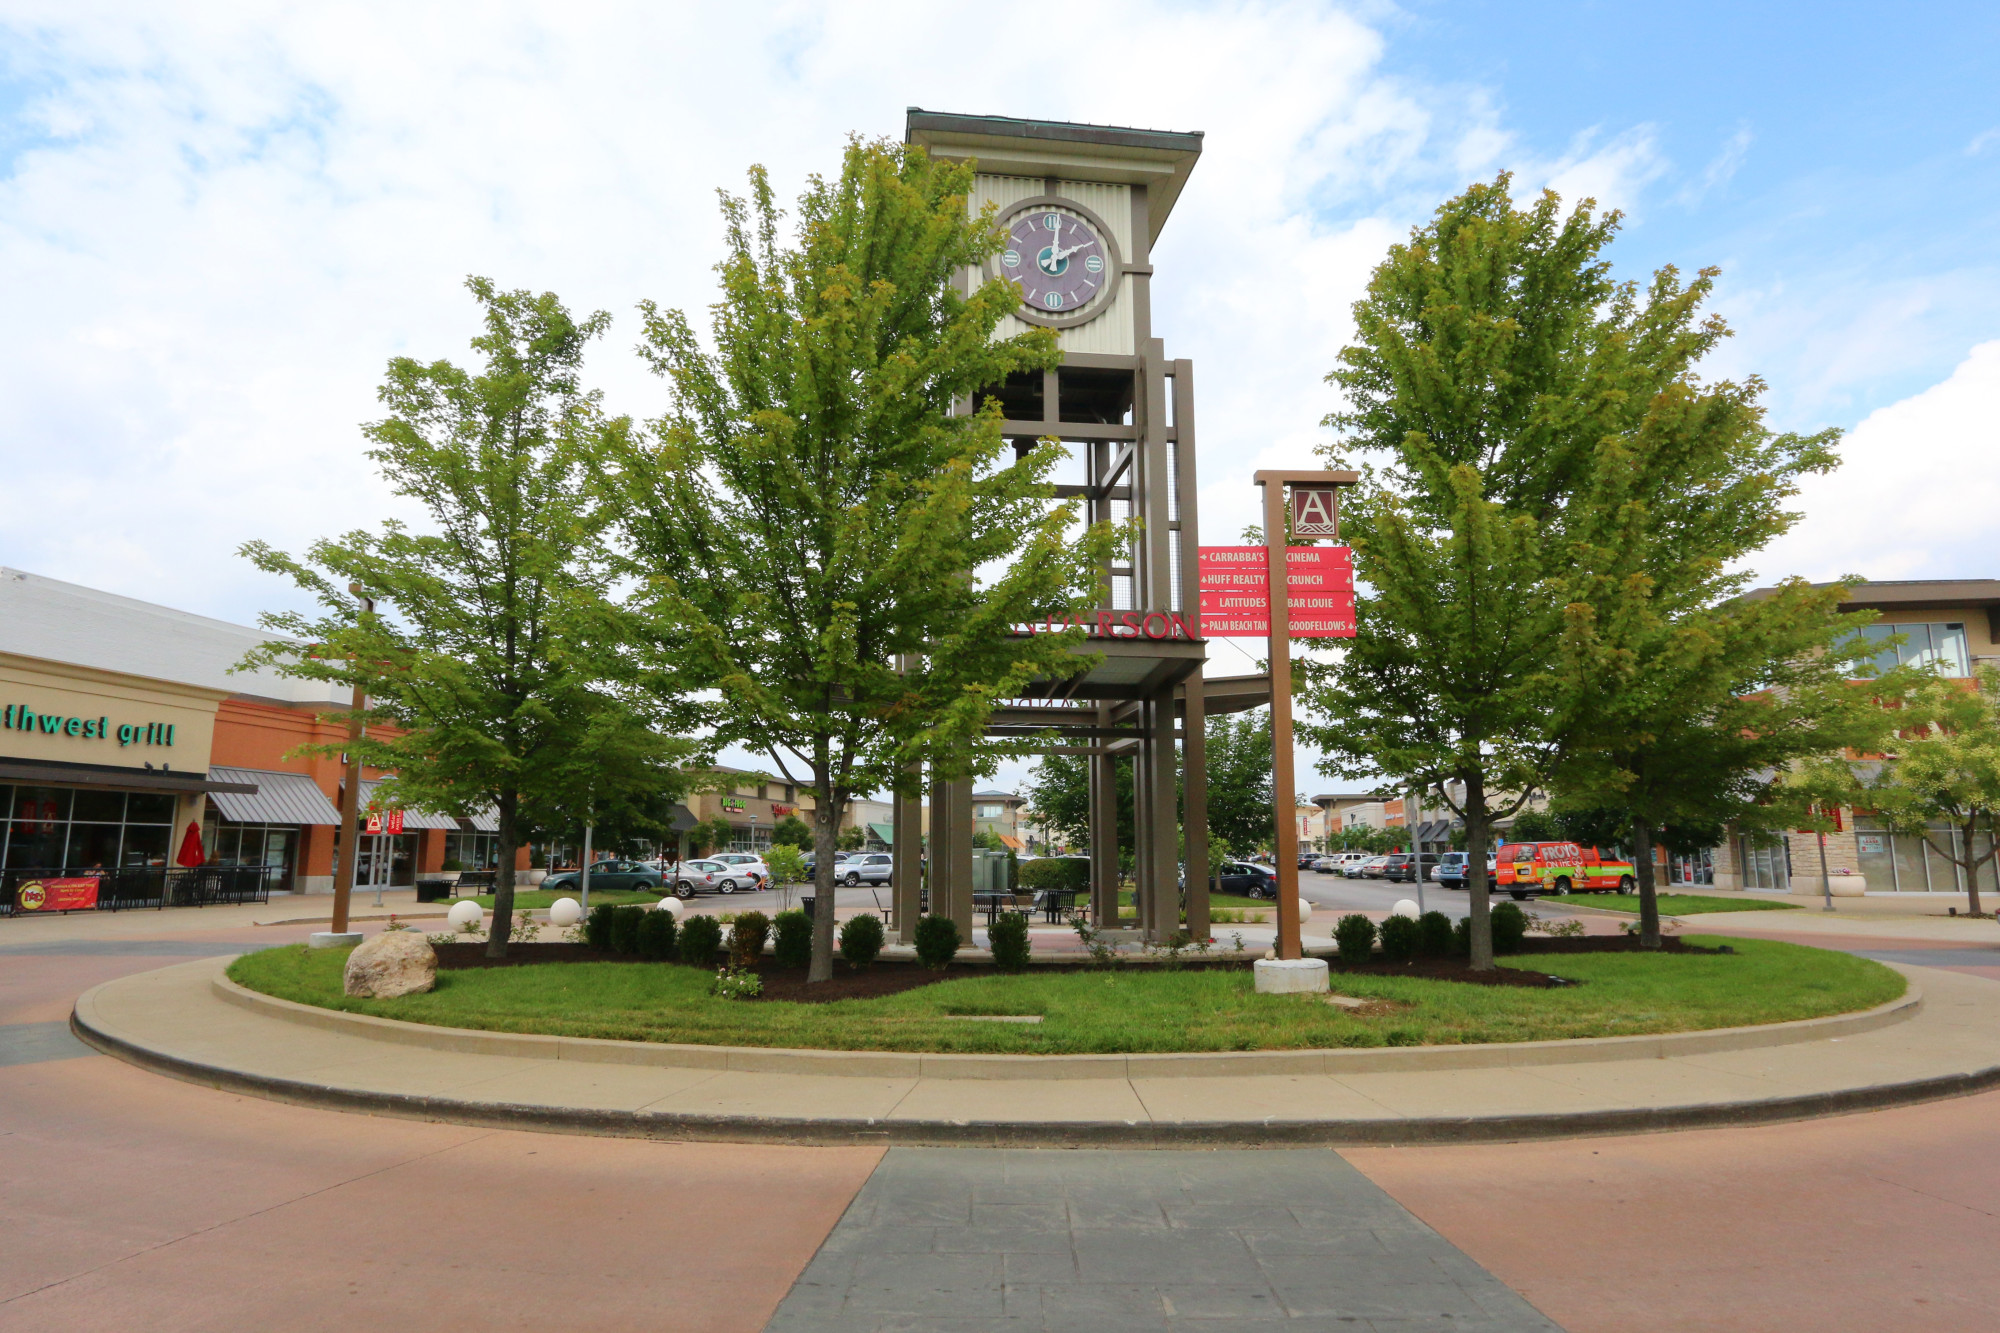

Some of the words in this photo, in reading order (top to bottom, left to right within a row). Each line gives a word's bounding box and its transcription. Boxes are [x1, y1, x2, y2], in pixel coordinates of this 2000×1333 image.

[1209, 552, 1265, 562] CARRABBA'S
[1285, 552, 1320, 562] CINEMA
[1207, 574, 1231, 584] HUFF
[1233, 574, 1265, 584] REALTY
[1286, 575, 1323, 585] CRUNCH
[1219, 597, 1267, 608] LATITUDES
[1287, 598, 1306, 608] BAR
[1307, 598, 1333, 608] LOUIE
[1209, 620, 1229, 631] PALM
[1230, 620, 1253, 631] BEACH
[1253, 620, 1268, 631] TAN
[1288, 621, 1346, 631] GOODFELLOWS
[0, 704, 109, 740] thwest
[117, 722, 176, 747] grill
[1541, 844, 1579, 861] FROYO
[1546, 860, 1558, 869] ON
[1559, 859, 1572, 867] THE
[1572, 856, 1583, 867] GO
